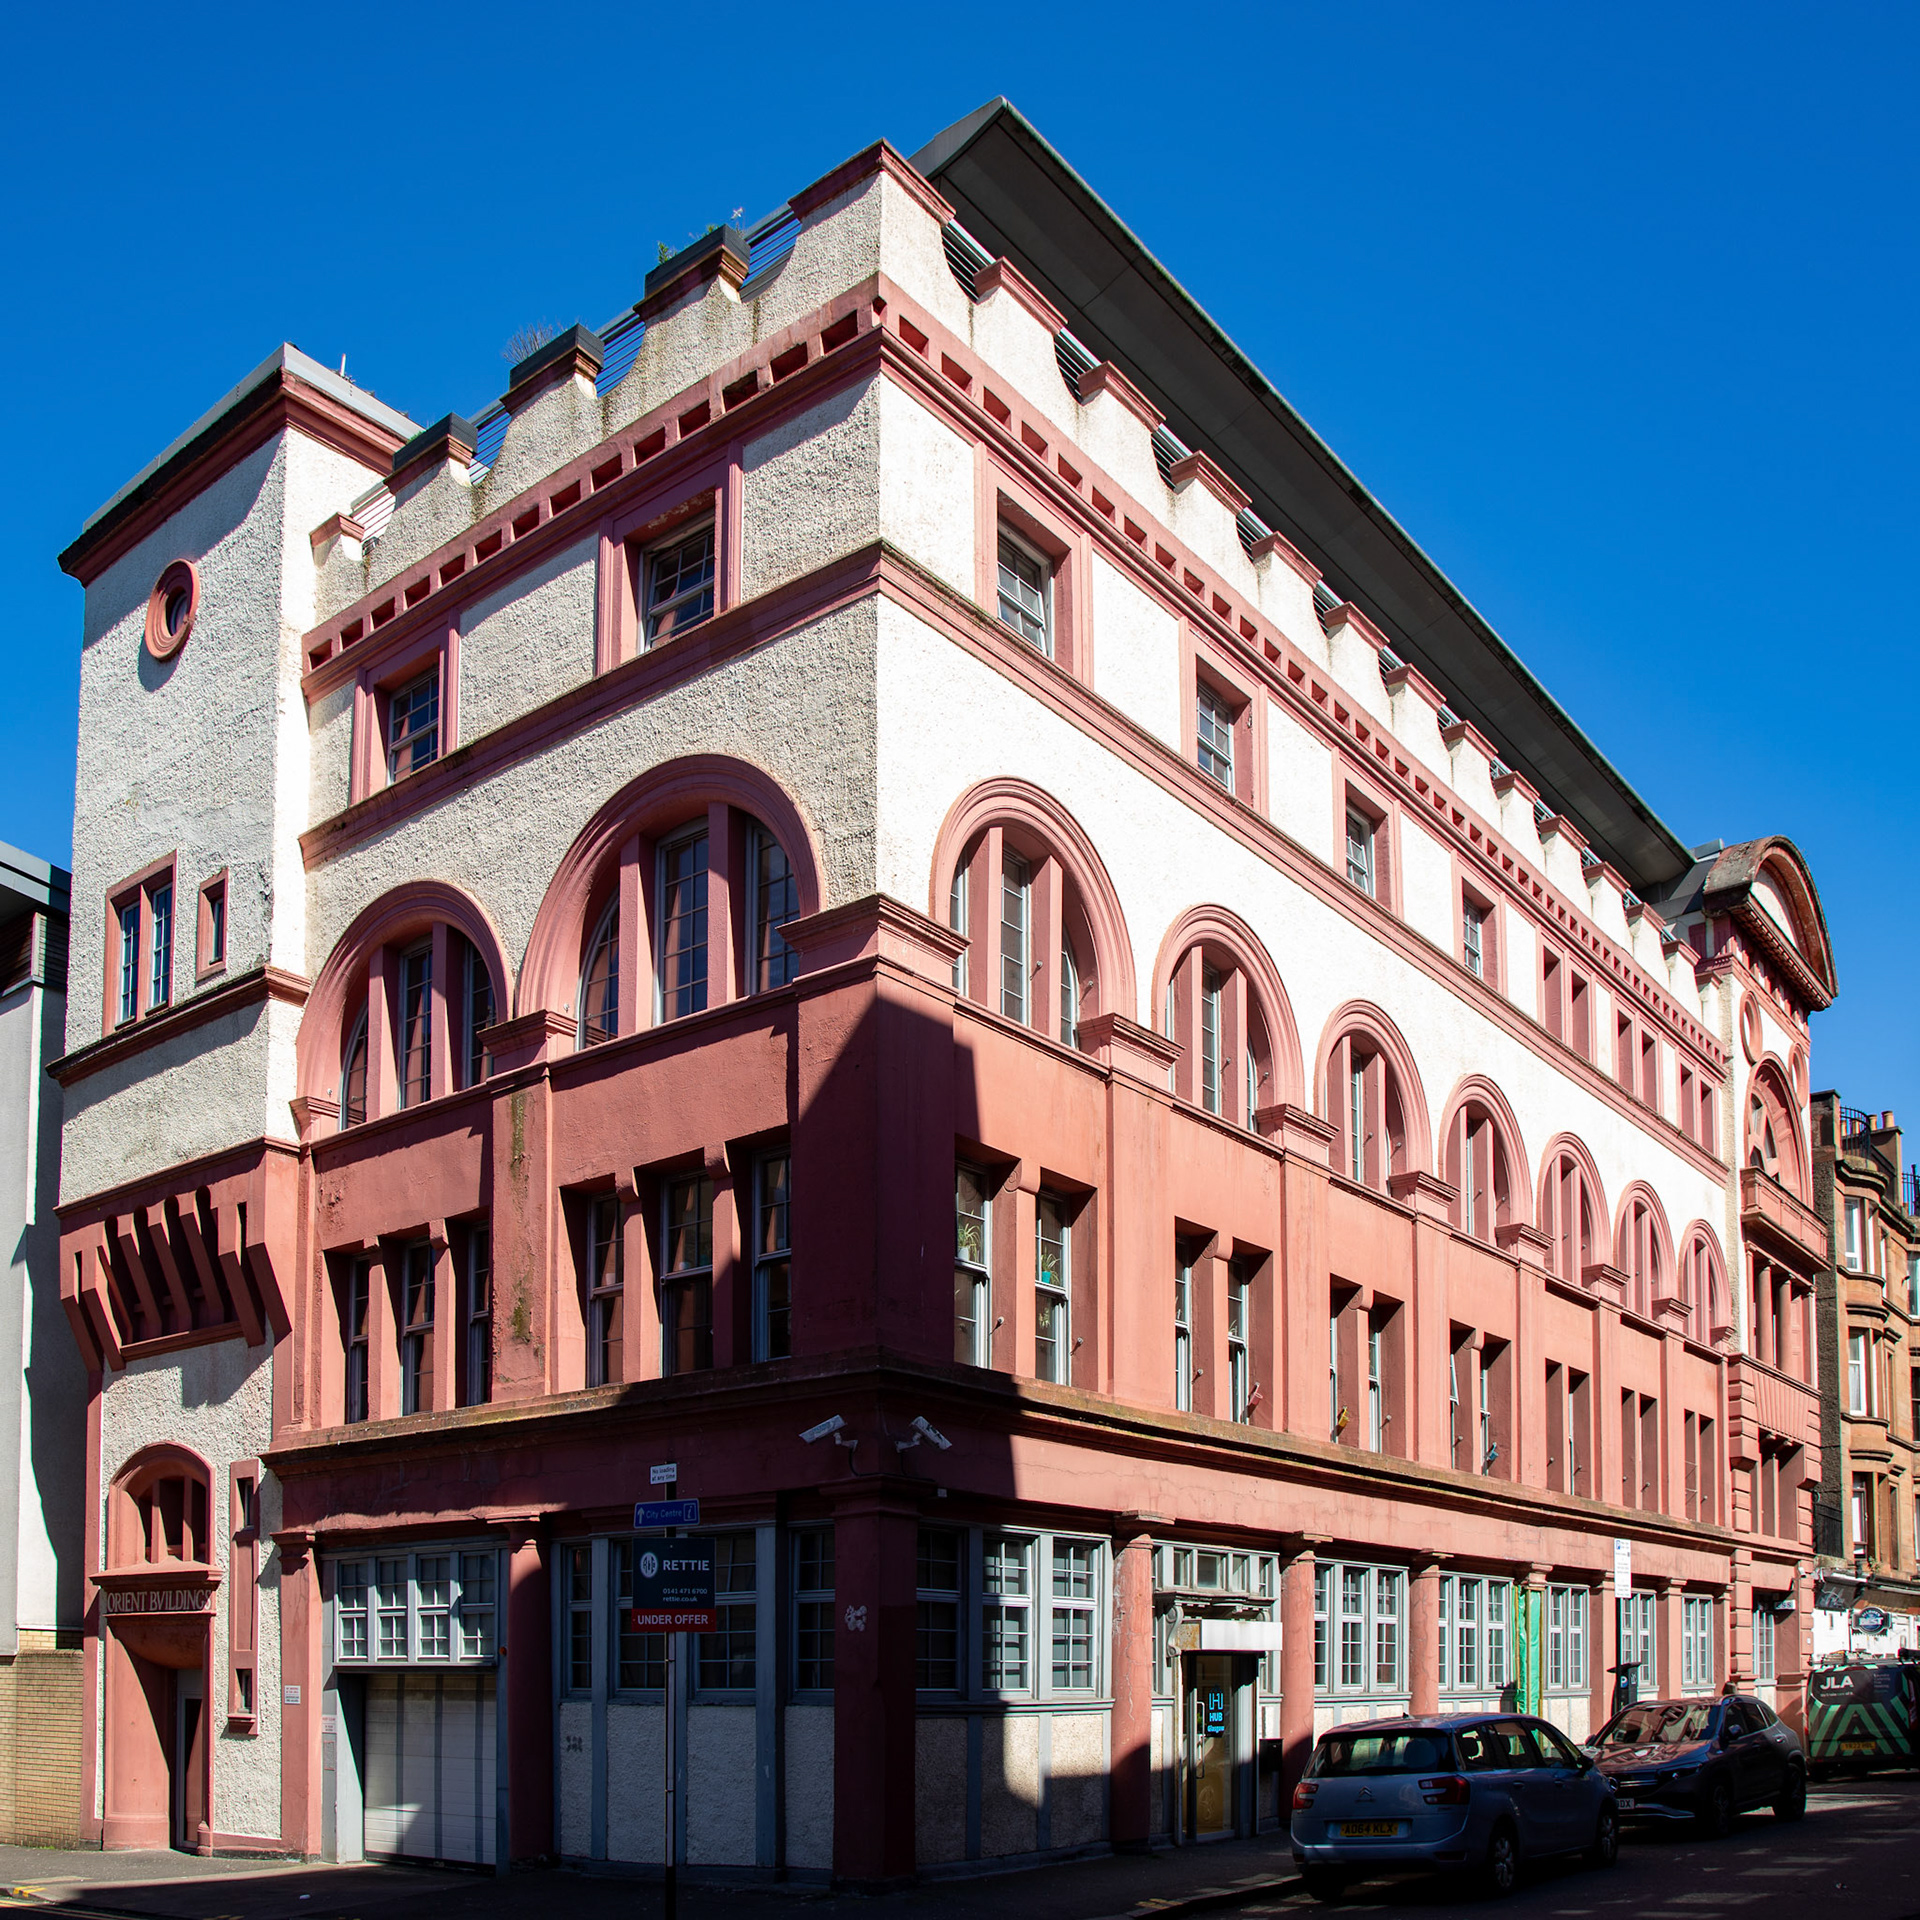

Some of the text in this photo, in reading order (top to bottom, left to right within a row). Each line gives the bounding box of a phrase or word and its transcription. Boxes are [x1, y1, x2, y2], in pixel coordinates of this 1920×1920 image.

[645, 1508, 683, 1520] City Centre
[662, 1559, 710, 1571] RETTIE
[662, 1587, 708, 1595] 0141 471 6700
[106, 1589, 212, 1613] ORIENT BVILDINGS
[637, 1614, 709, 1625] UNDER OFFER
[1818, 1675, 1854, 1690] JLA
[1208, 1712, 1223, 1722] HUB
